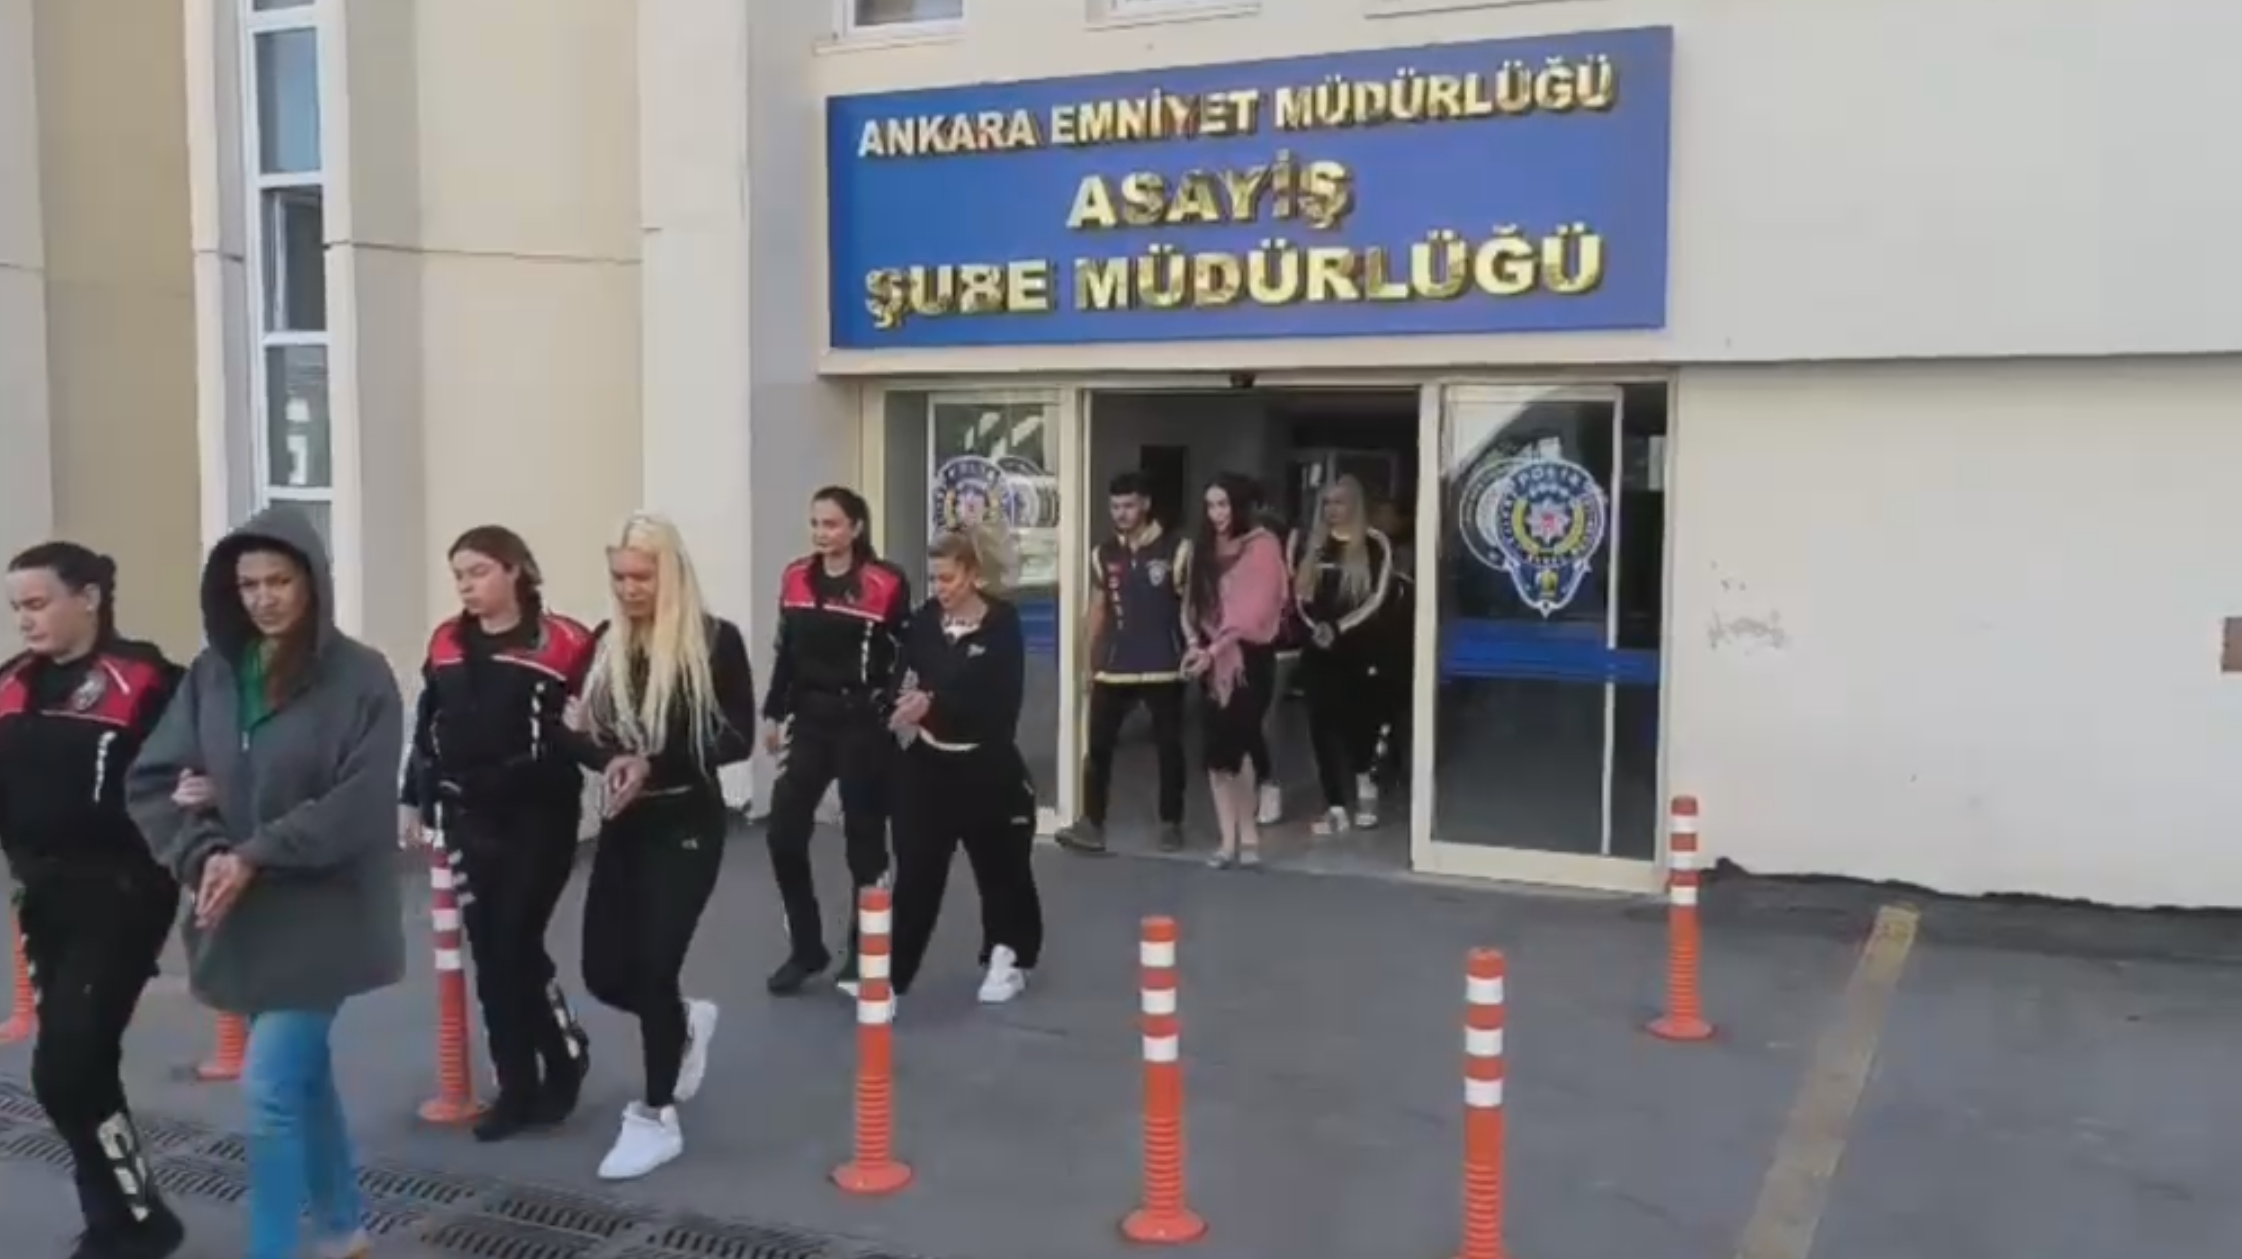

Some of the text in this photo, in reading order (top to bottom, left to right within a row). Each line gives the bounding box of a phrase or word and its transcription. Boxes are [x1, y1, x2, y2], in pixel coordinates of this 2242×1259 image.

[858, 54, 1614, 157] ANKARA EMNİYET MÜDÜRLÜĞÜ
[1066, 149, 1350, 229] ASAYİŞ
[865, 221, 1603, 329] ŞUBE MÜDÜRLÜĞÜ
